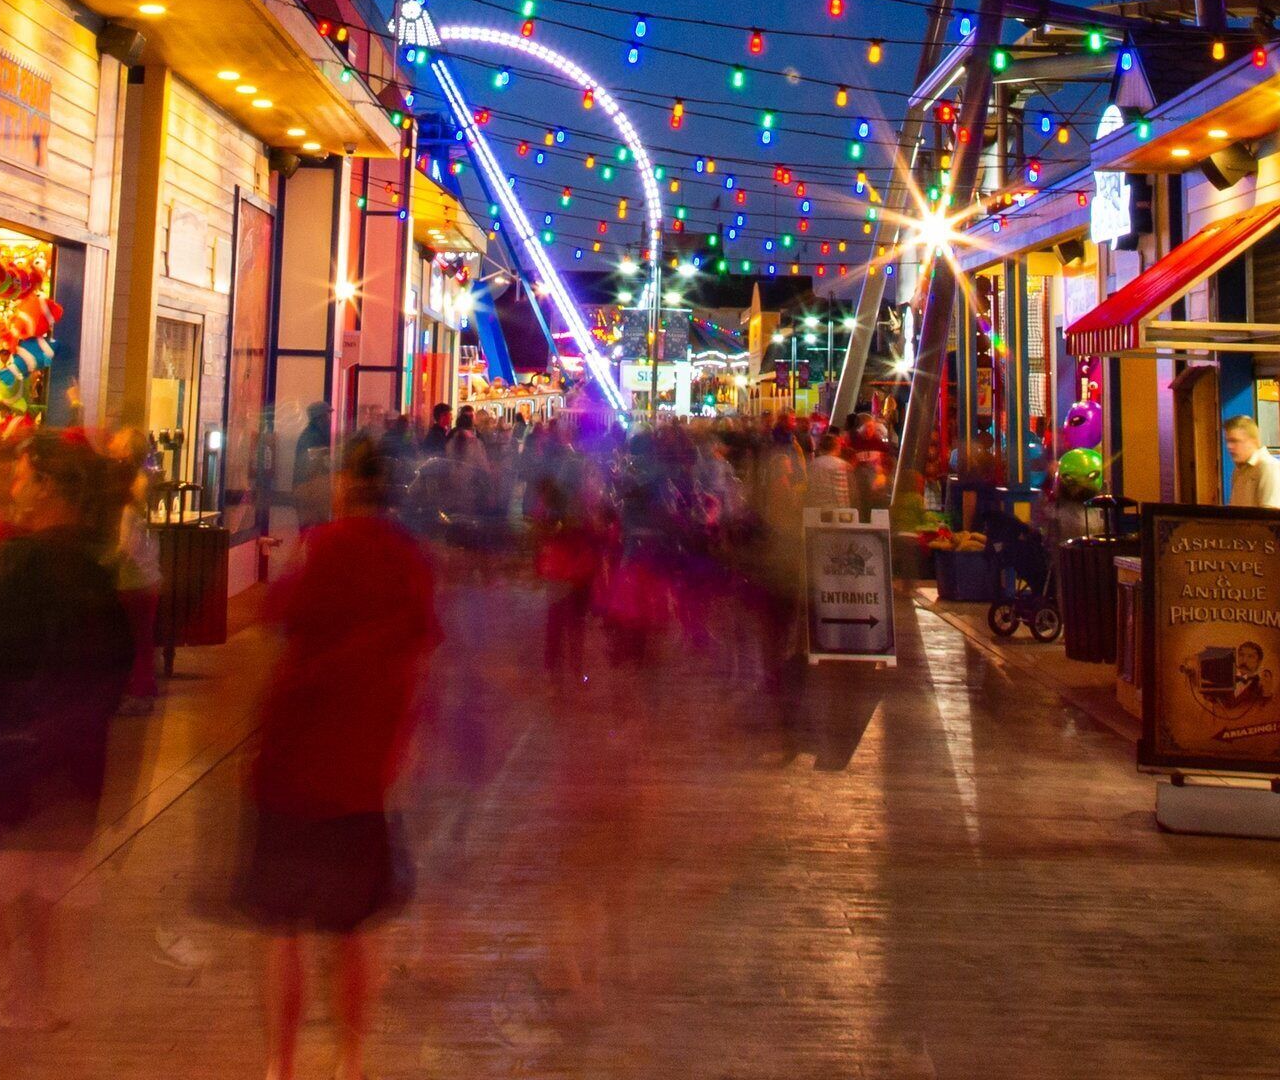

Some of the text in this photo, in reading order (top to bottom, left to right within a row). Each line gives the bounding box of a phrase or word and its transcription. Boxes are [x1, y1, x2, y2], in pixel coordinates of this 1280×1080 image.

[1186, 559, 1265, 577] TINTYPE
[820, 590, 880, 605] ENTRANCE
[1182, 583, 1267, 602] ANTIQUE
[1170, 605, 1280, 628] PHOTORIUM
